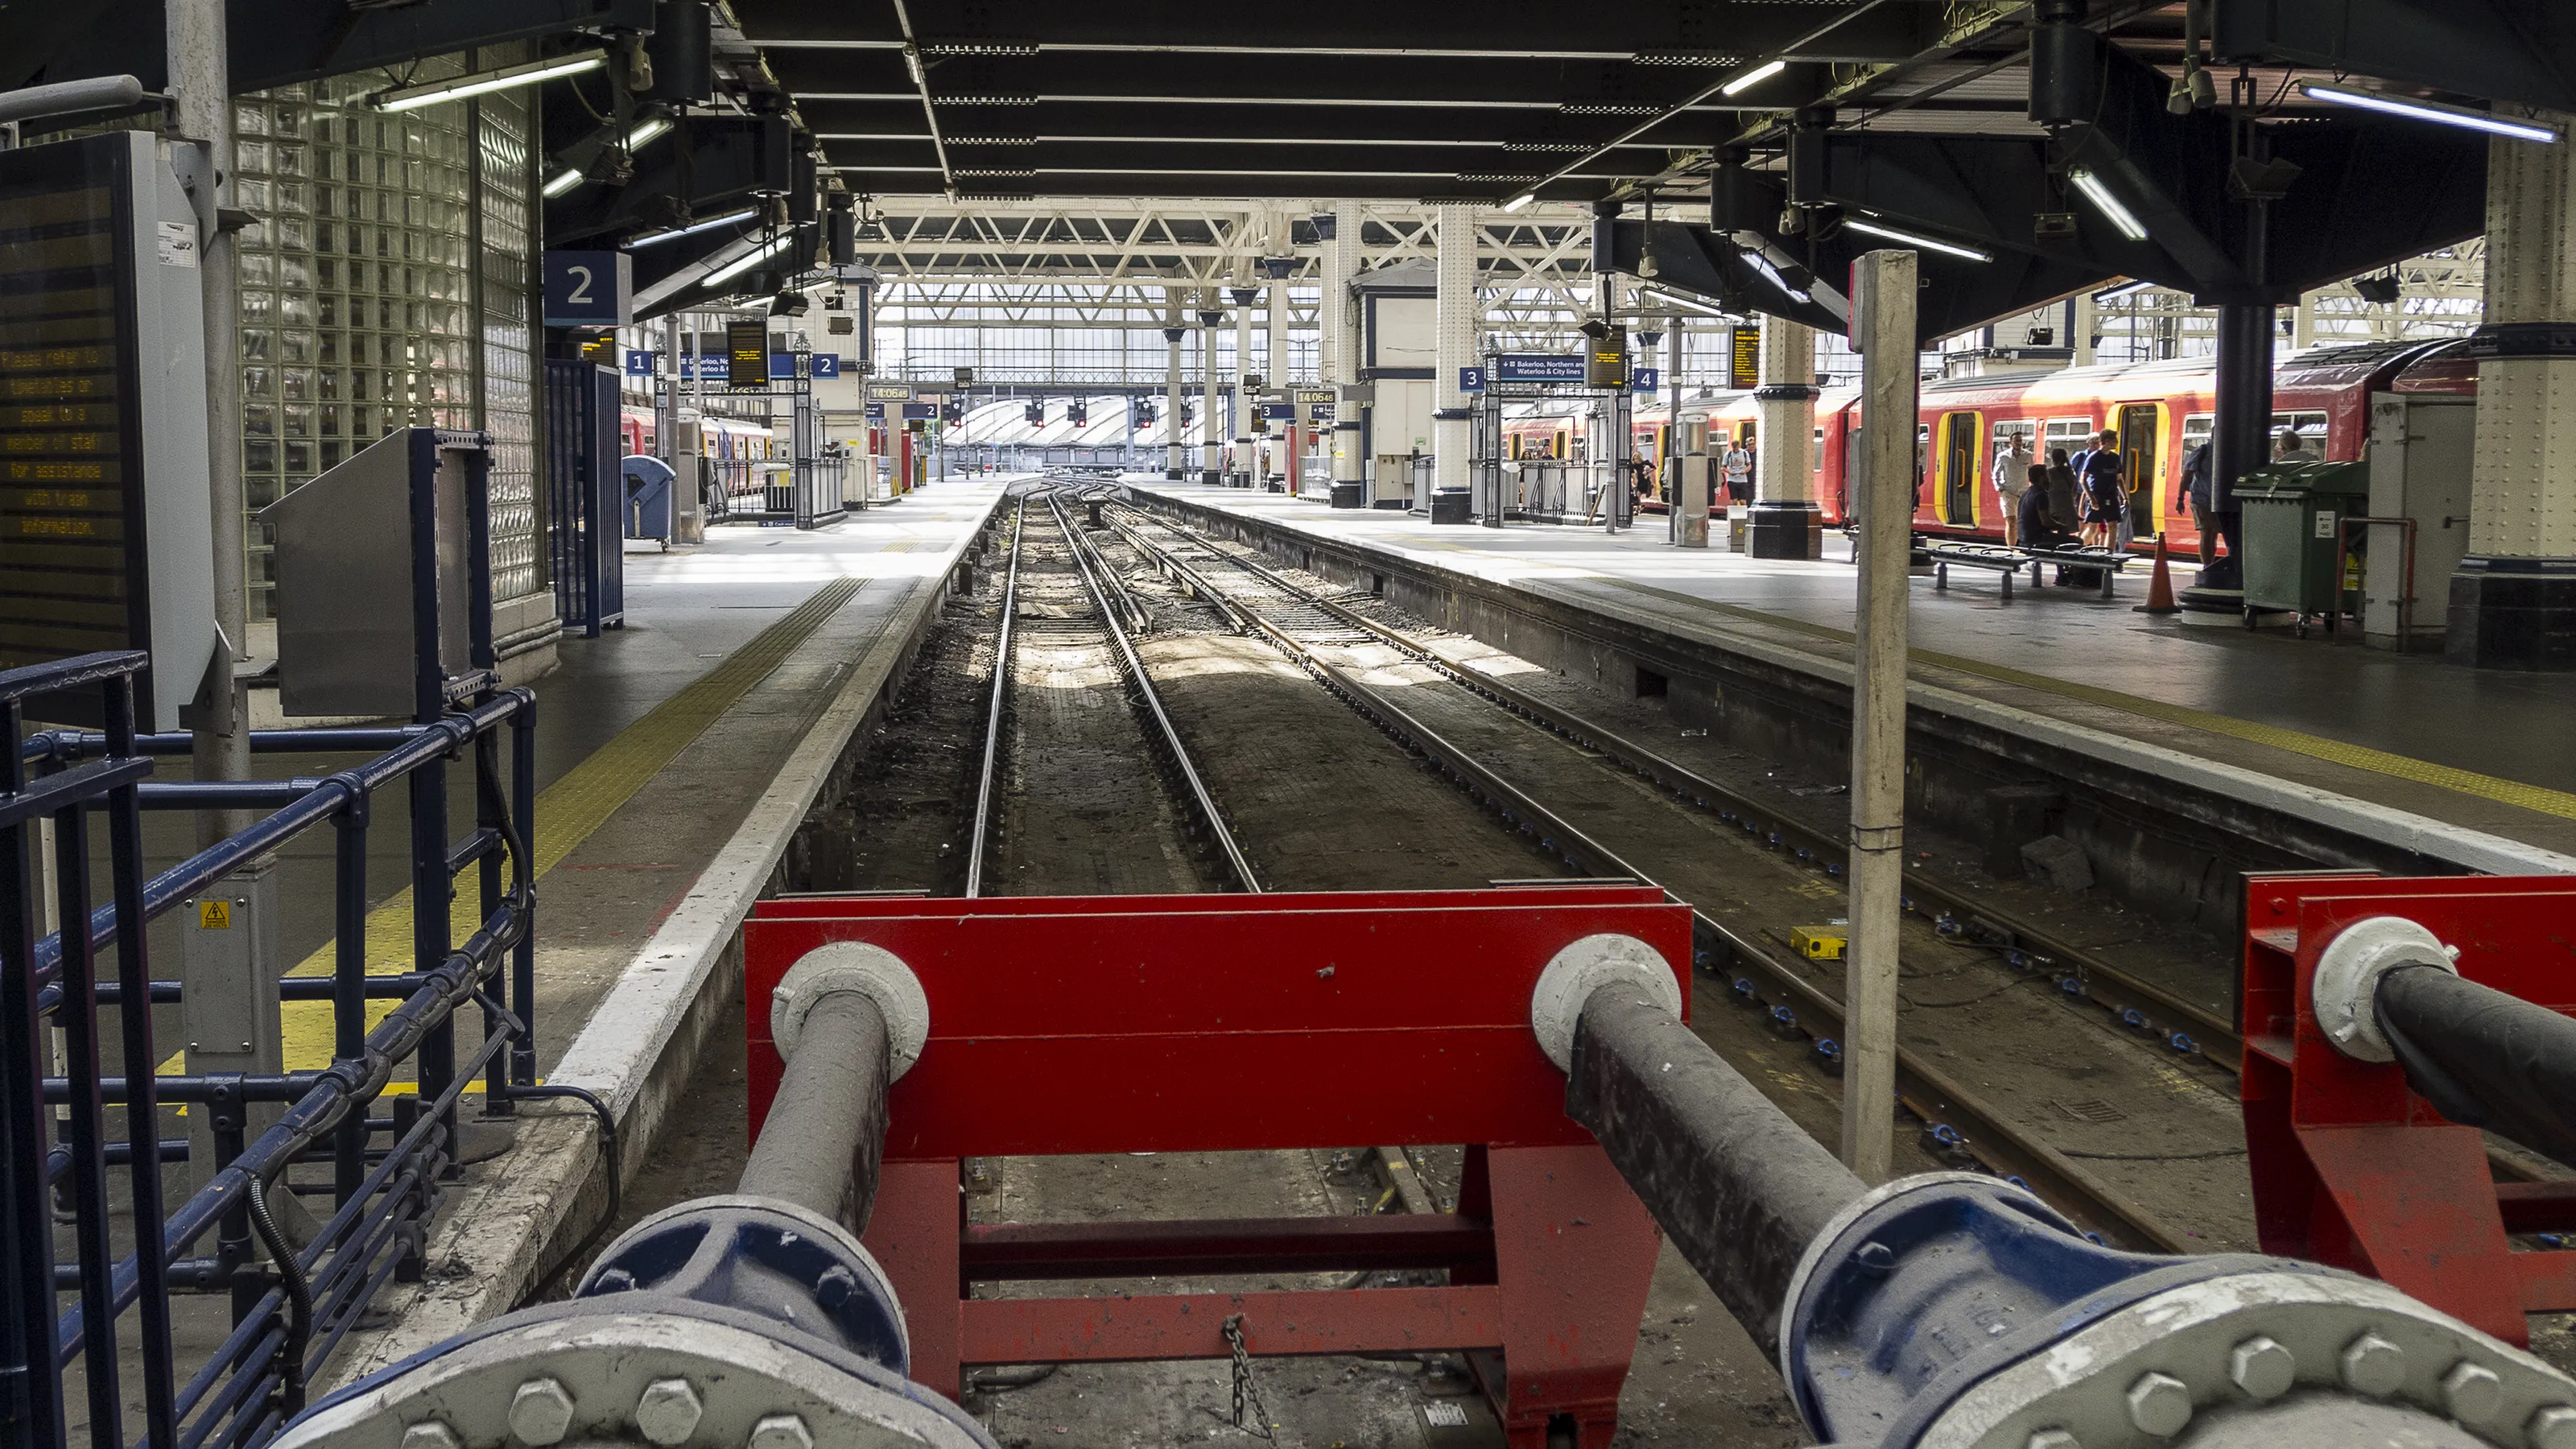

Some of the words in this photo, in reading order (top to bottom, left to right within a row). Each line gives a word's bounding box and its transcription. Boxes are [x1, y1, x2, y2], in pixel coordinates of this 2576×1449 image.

[567, 266, 592, 303] 2
[634, 355, 644, 369] 1
[821, 358, 832, 373] 2
[1468, 371, 1477, 386] 3
[1641, 373, 1651, 386] 4
[927, 406, 935, 415] 2
[1263, 407, 1270, 416] 3
